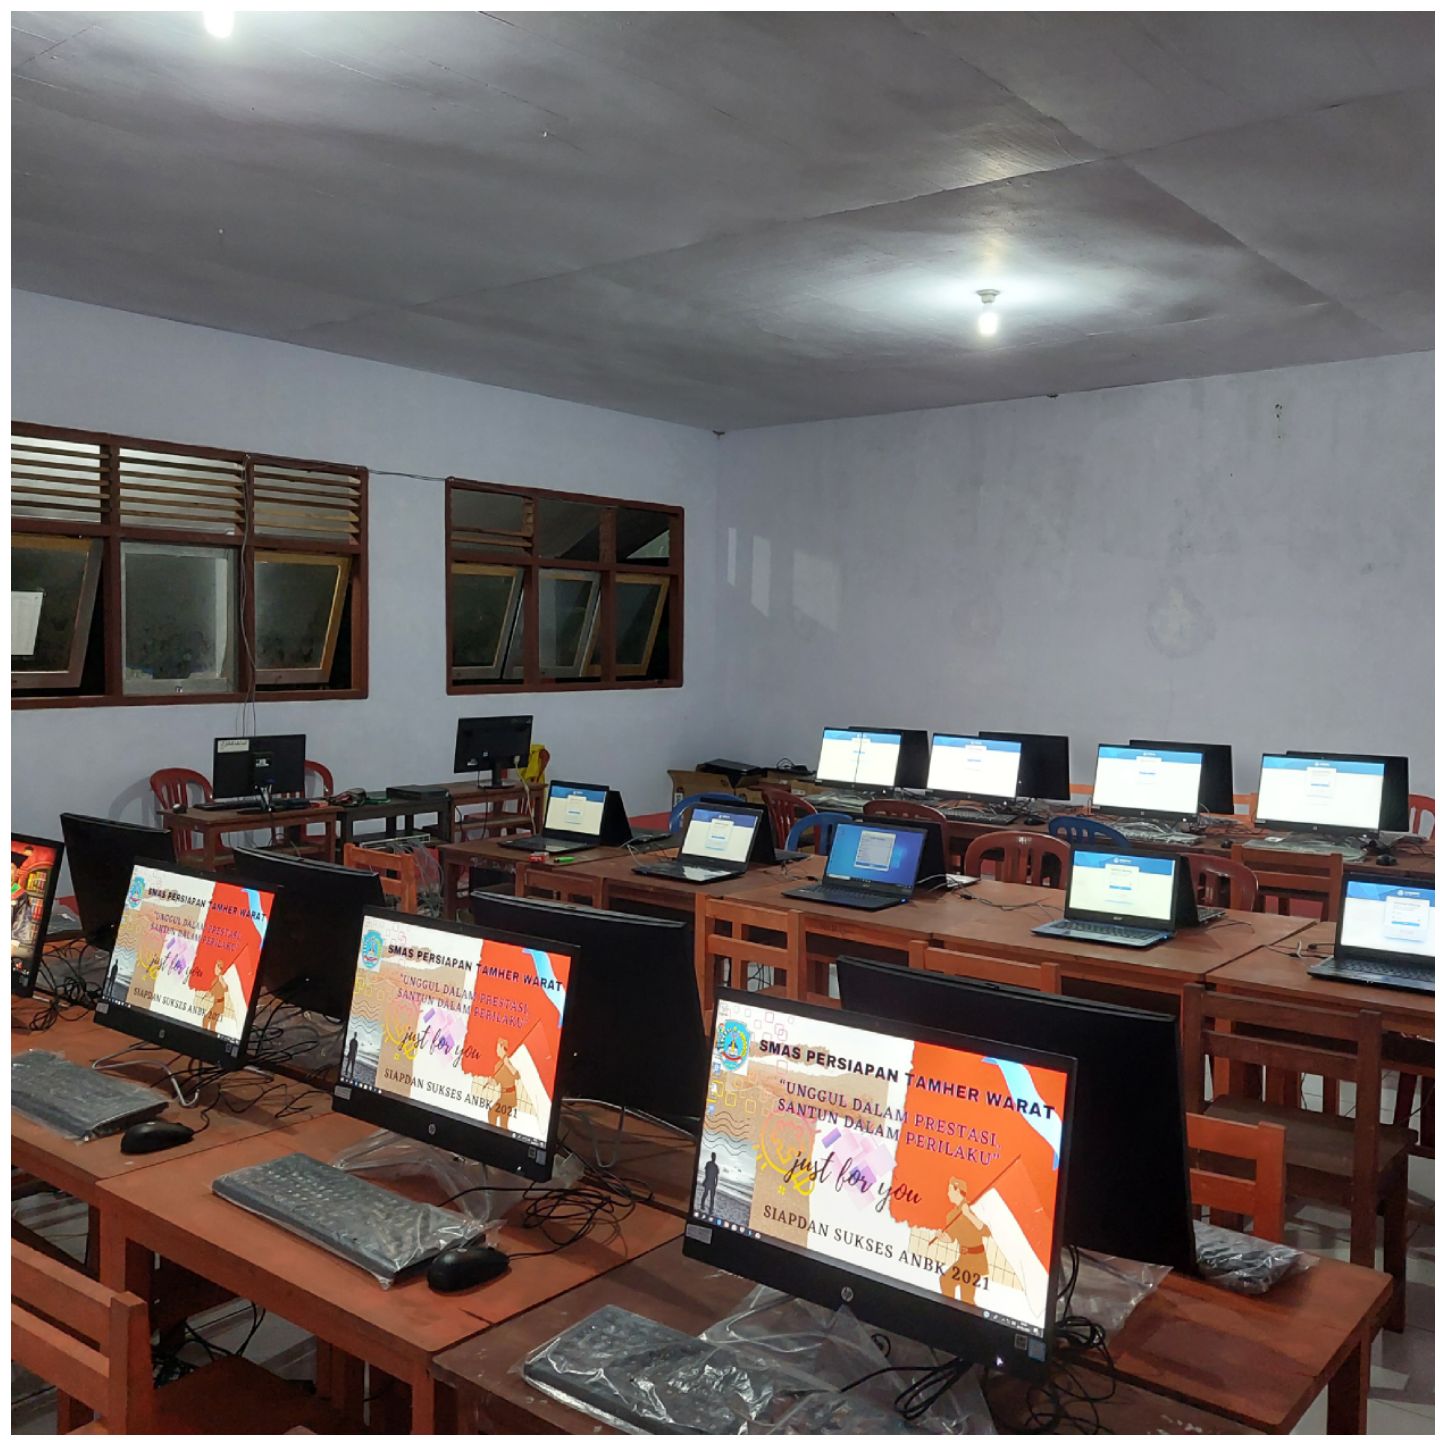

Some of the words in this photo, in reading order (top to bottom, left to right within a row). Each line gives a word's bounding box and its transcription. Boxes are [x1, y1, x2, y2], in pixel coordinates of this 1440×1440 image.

[167, 889, 206, 908] PERSIAPAN
[240, 908, 267, 922] WARAT
[387, 944, 414, 959] SMAS
[416, 948, 473, 971] PERSIAPAN
[476, 963, 520, 981] TAMHER
[522, 975, 564, 992] WARAT
[397, 988, 435, 1006] SANTUN
[436, 997, 471, 1015] DALAM
[442, 985, 476, 1001] DALAM
[397, 1022, 431, 1052] just
[429, 1024, 456, 1056] for
[452, 1043, 481, 1069] you
[384, 1067, 425, 1090] SIAPDAN
[426, 1079, 463, 1102] SUKSES
[463, 1093, 494, 1111] ANBK
[494, 1101, 518, 1120] 2021
[759, 1038, 802, 1063] SMAS
[806, 1049, 899, 1084] PERSIAPAN
[905, 1071, 980, 1103] TAMHER
[986, 1090, 1056, 1121] WARAT
[777, 1098, 839, 1126] SANTUN
[844, 1114, 901, 1142] DALAM
[852, 1097, 908, 1125] DALAM
[914, 1114, 1002, 1149] PRESTASI,
[783, 1150, 835, 1185] just
[834, 1157, 873, 1194] for
[875, 1179, 923, 1214] you
[763, 1204, 829, 1239] SIAPDAN
[833, 1226, 895, 1259] SUKSES
[898, 1248, 947, 1277] ANBK
[951, 1265, 991, 1291] 2021
